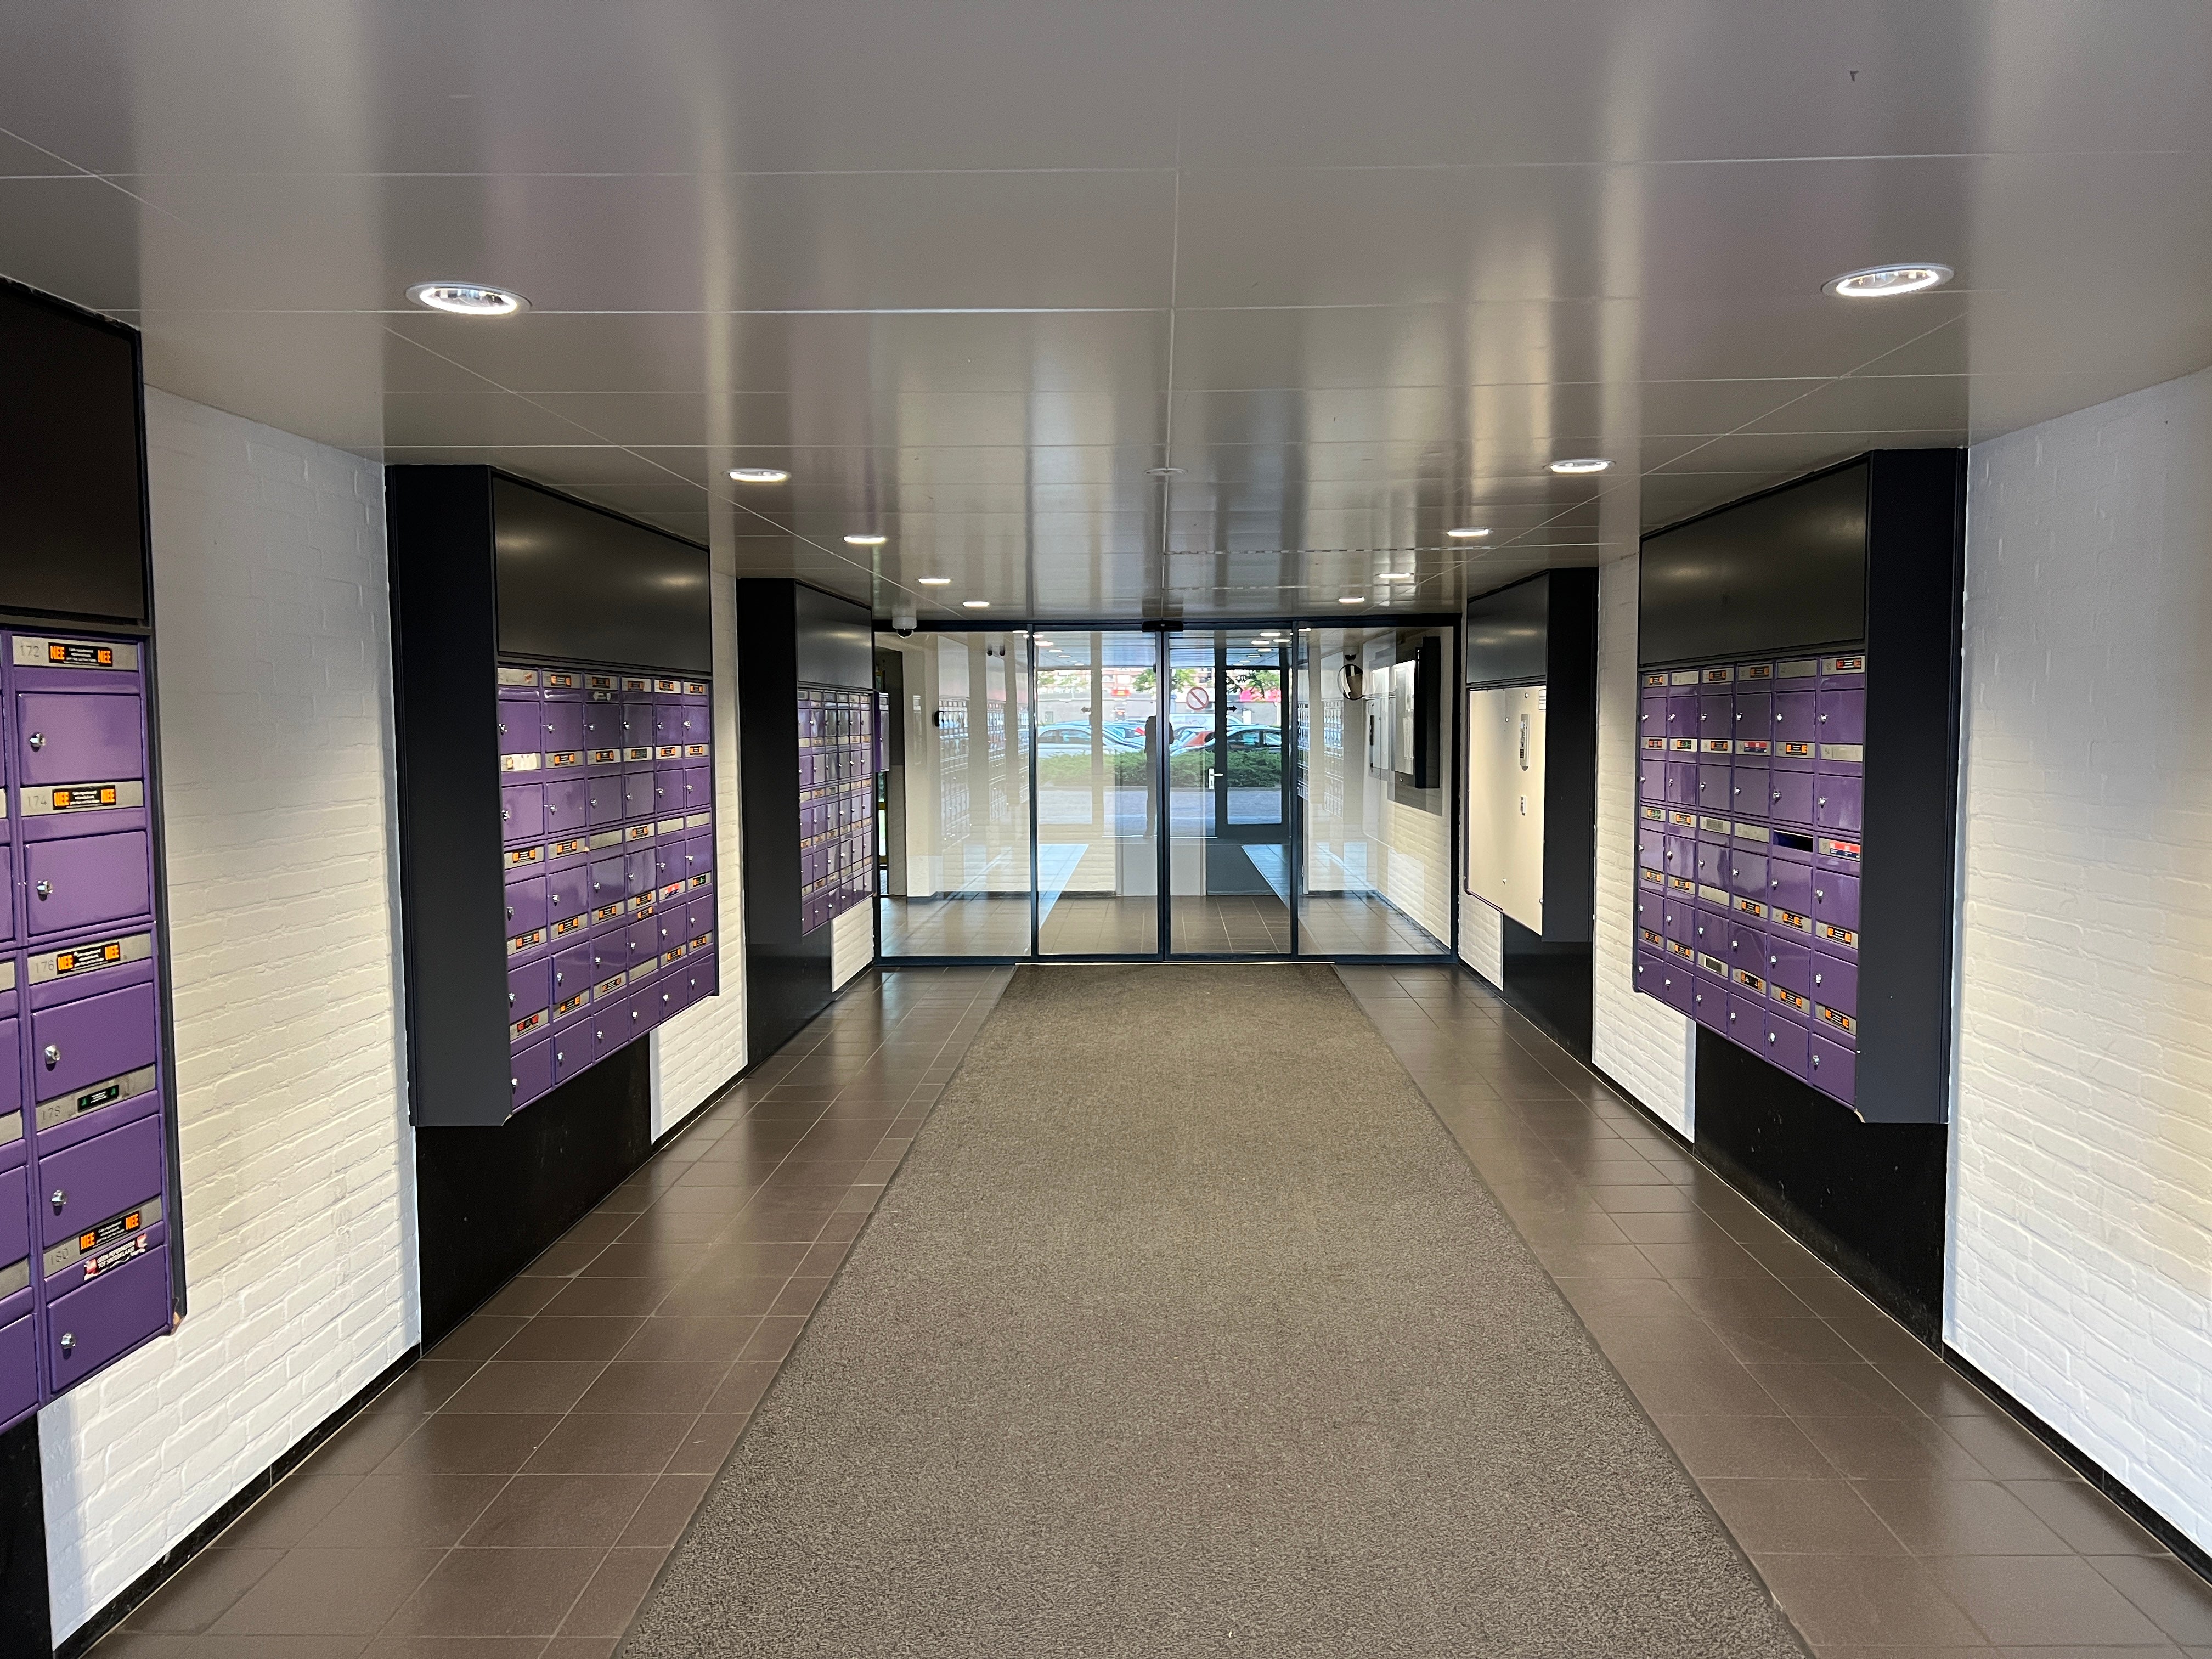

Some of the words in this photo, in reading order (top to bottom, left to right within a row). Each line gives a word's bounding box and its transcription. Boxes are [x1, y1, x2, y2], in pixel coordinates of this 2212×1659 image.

[20, 645, 40, 657] 172
[50, 646, 65, 660] NEE
[98, 650, 111, 663] NEE
[27, 795, 47, 807] 174
[35, 960, 54, 974] 176
[126, 1213, 139, 1230] NEE
[80, 1232, 95, 1250] NEE
